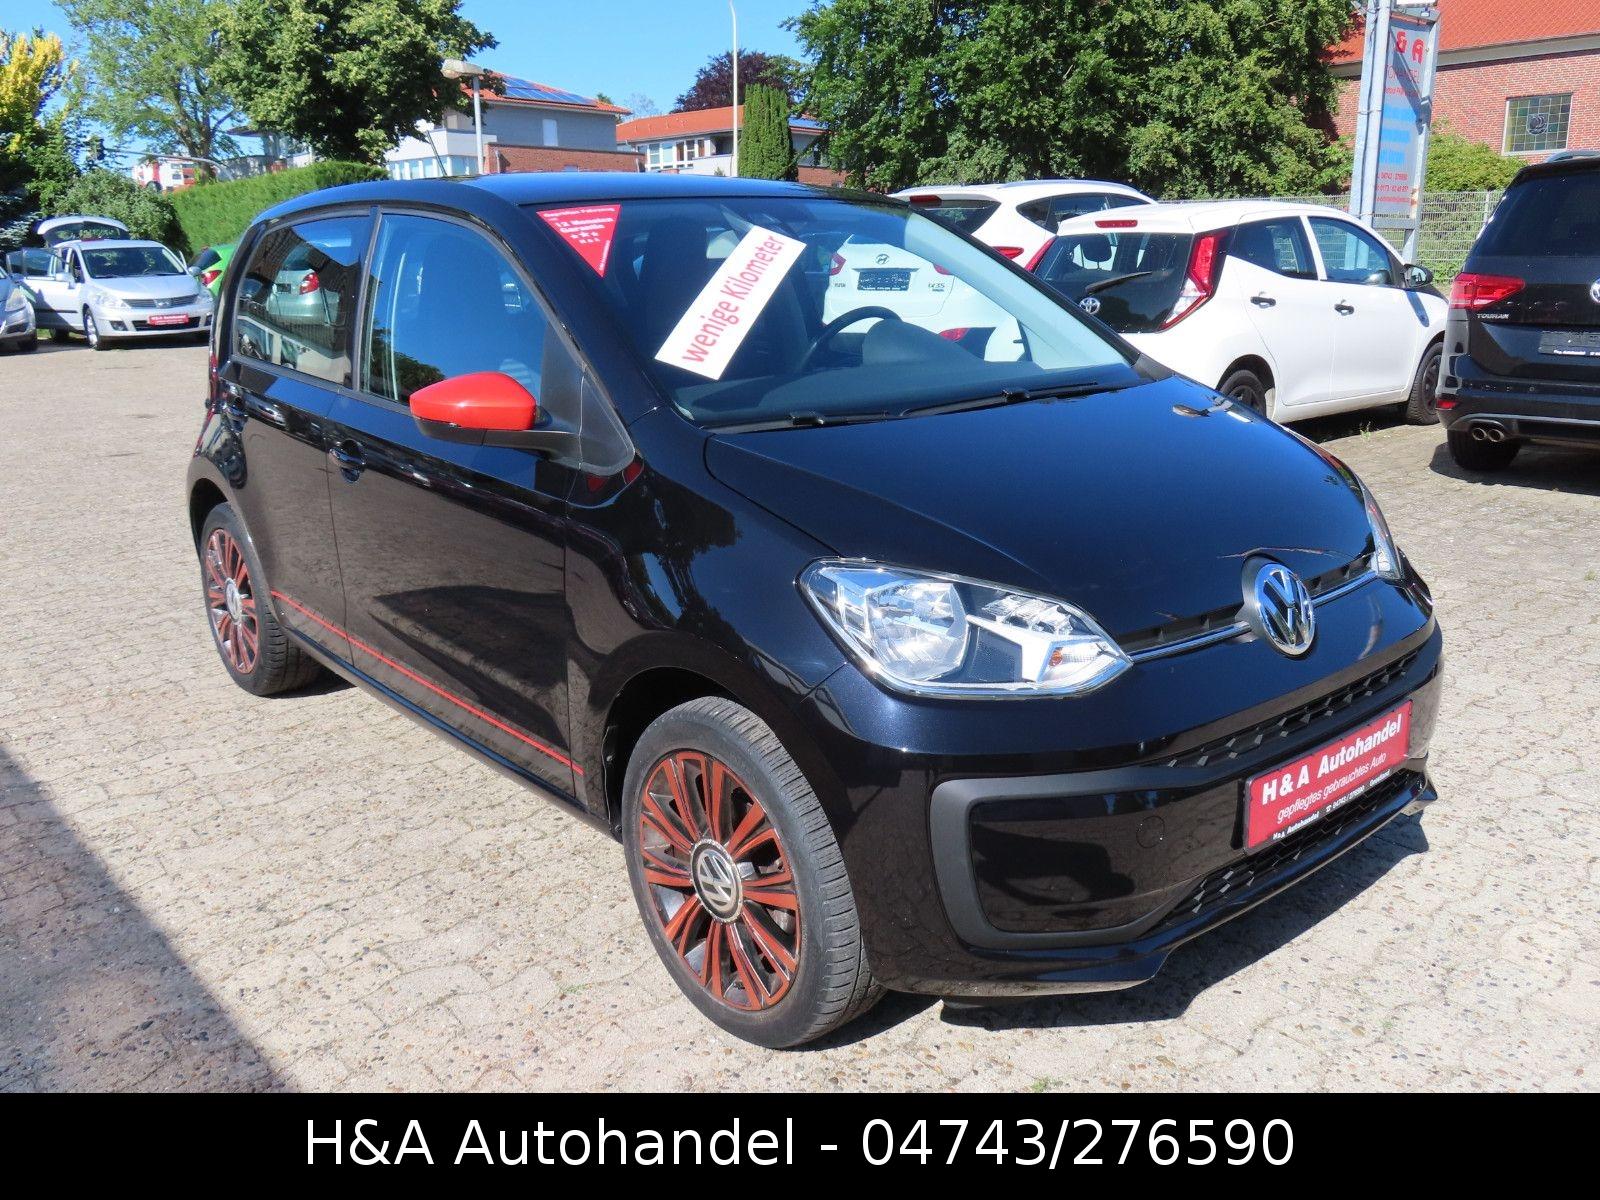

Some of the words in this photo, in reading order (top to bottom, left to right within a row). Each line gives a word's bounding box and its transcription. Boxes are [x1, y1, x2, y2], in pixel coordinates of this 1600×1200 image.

[682, 301, 740, 363] wenige
[720, 235, 785, 300] Kilometer
[1316, 712, 1403, 779] Autohandel
[1276, 788, 1323, 825] gepflegtes
[1322, 761, 1371, 800] gebrauchtes
[1369, 752, 1387, 768] Auto
